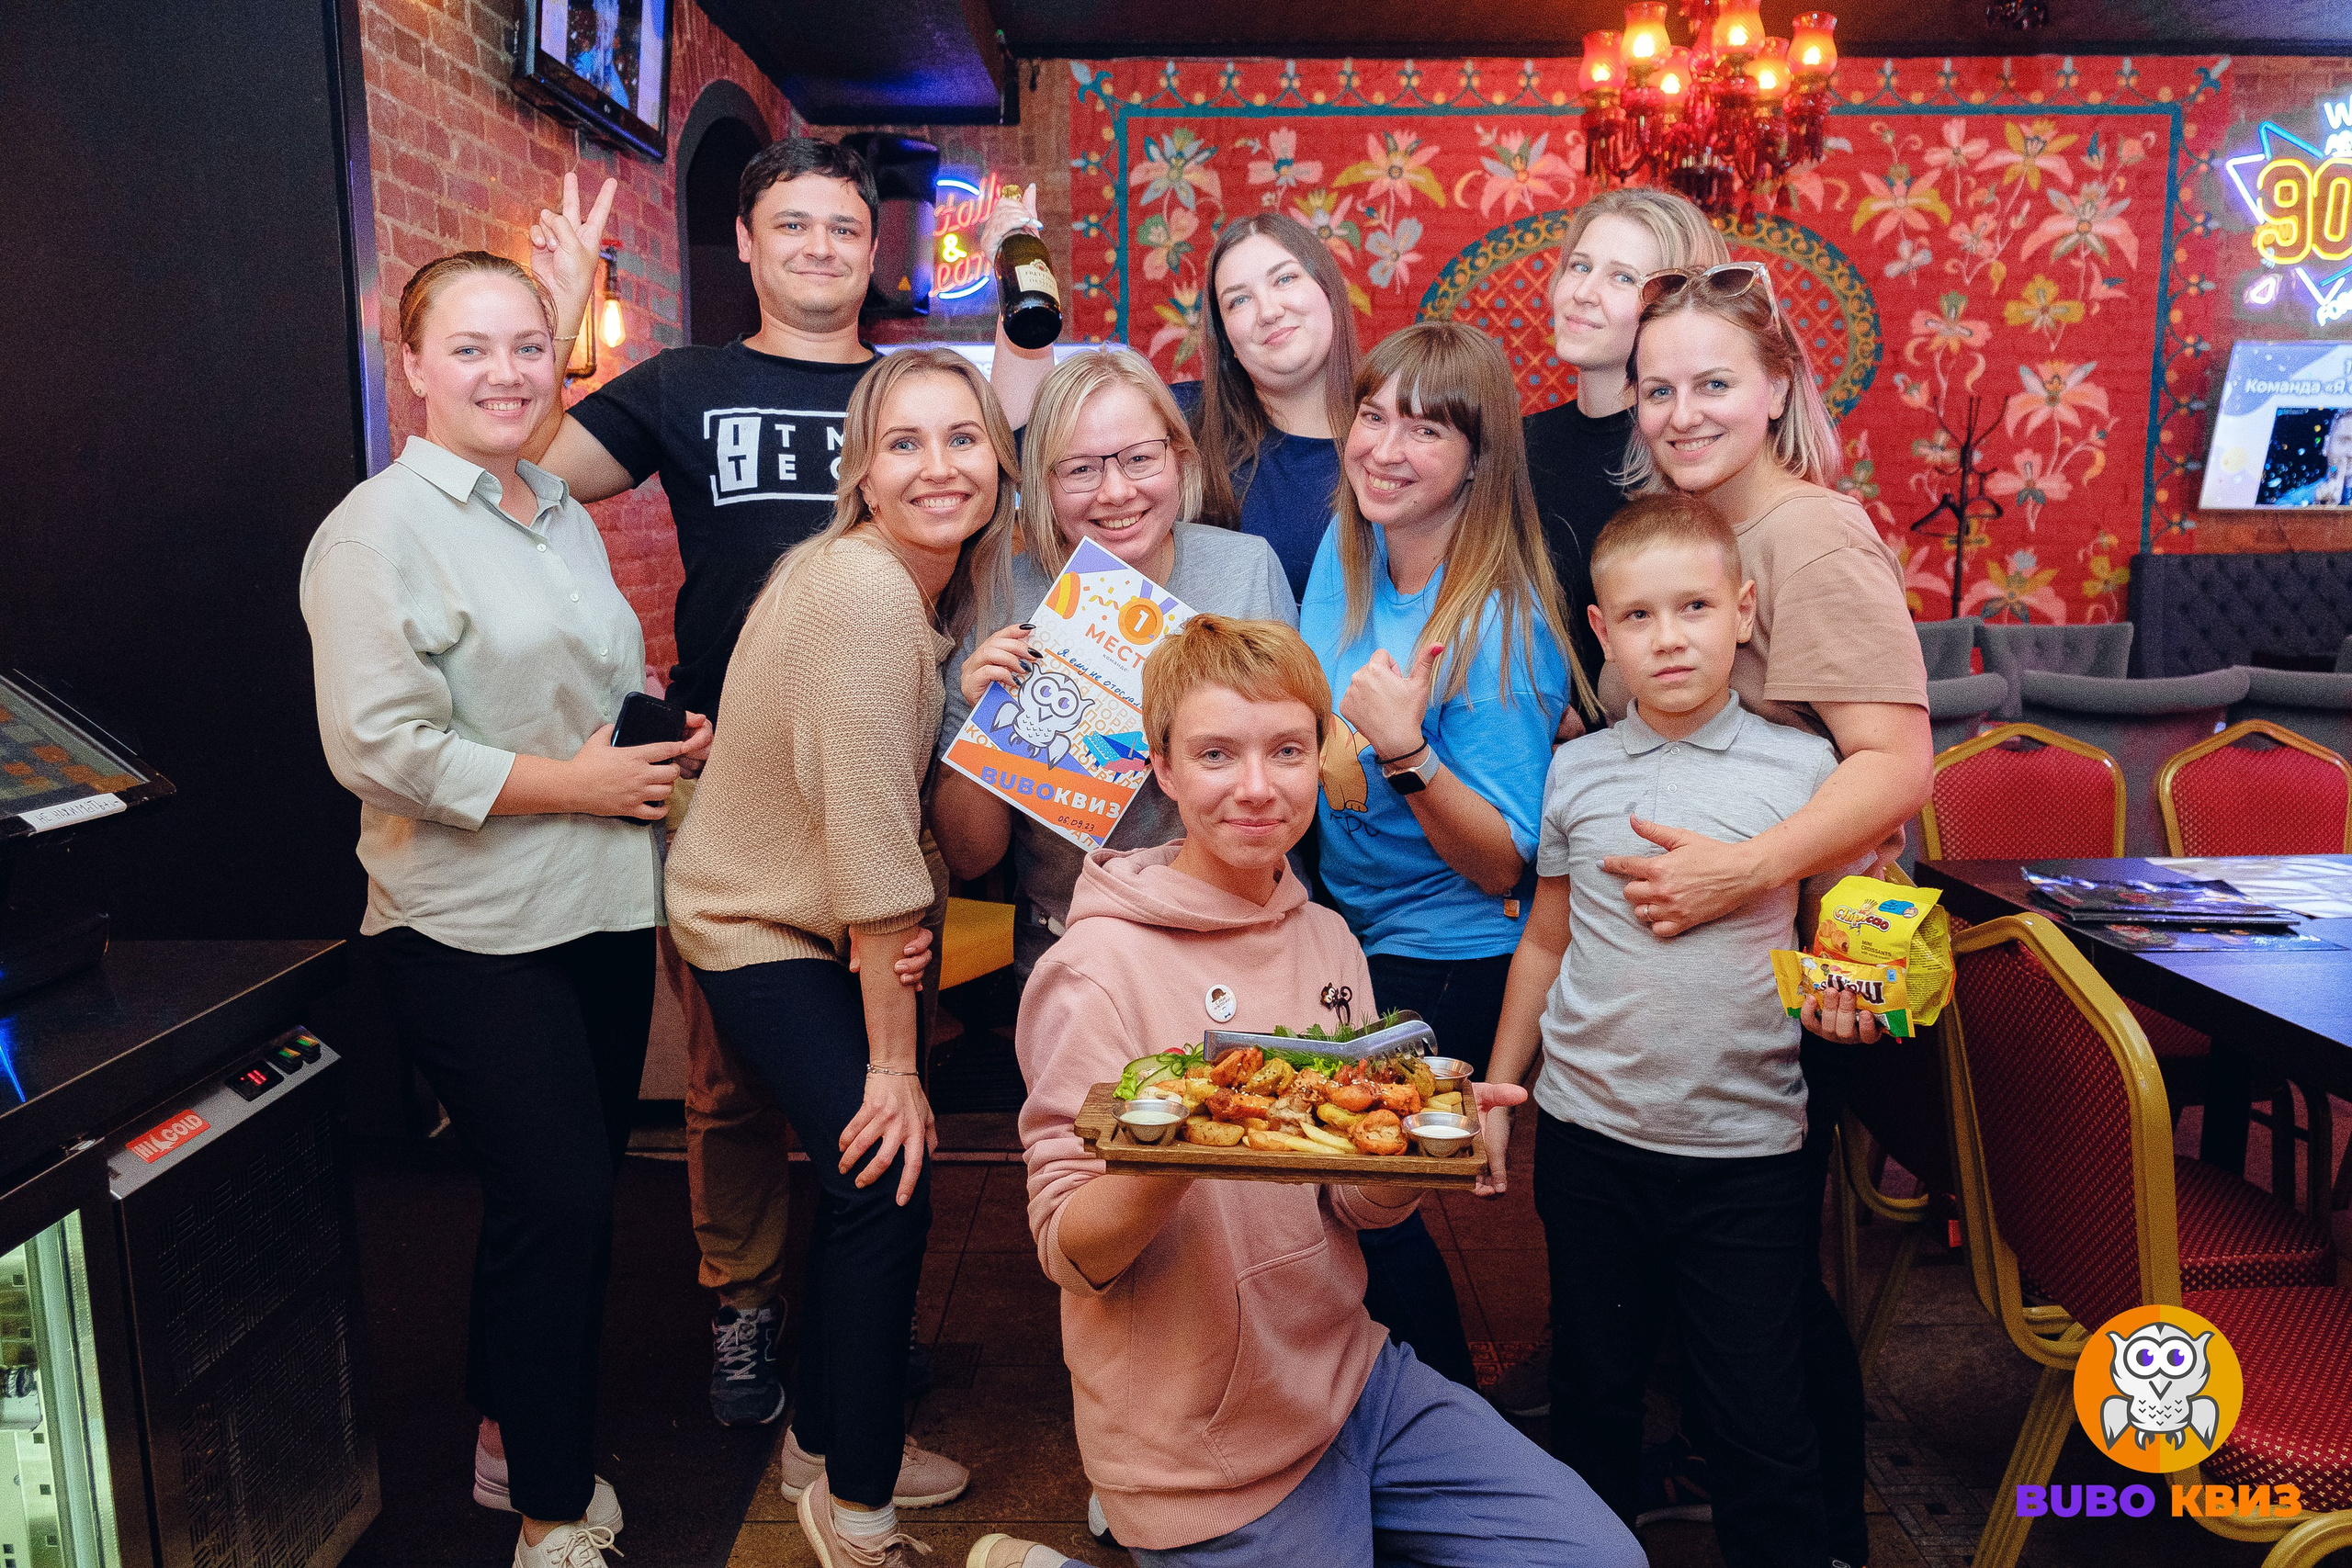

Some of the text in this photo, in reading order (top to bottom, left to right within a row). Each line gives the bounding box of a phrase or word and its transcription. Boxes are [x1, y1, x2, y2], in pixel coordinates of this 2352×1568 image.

[943, 233, 967, 263] &
[2245, 378, 2322, 395] Команда
[1134, 610, 1149, 633] 1
[1085, 623, 1146, 669] МЕСТ
[1057, 649, 1142, 708] Я ему не отослал
[35, 812, 51, 825] НЕ
